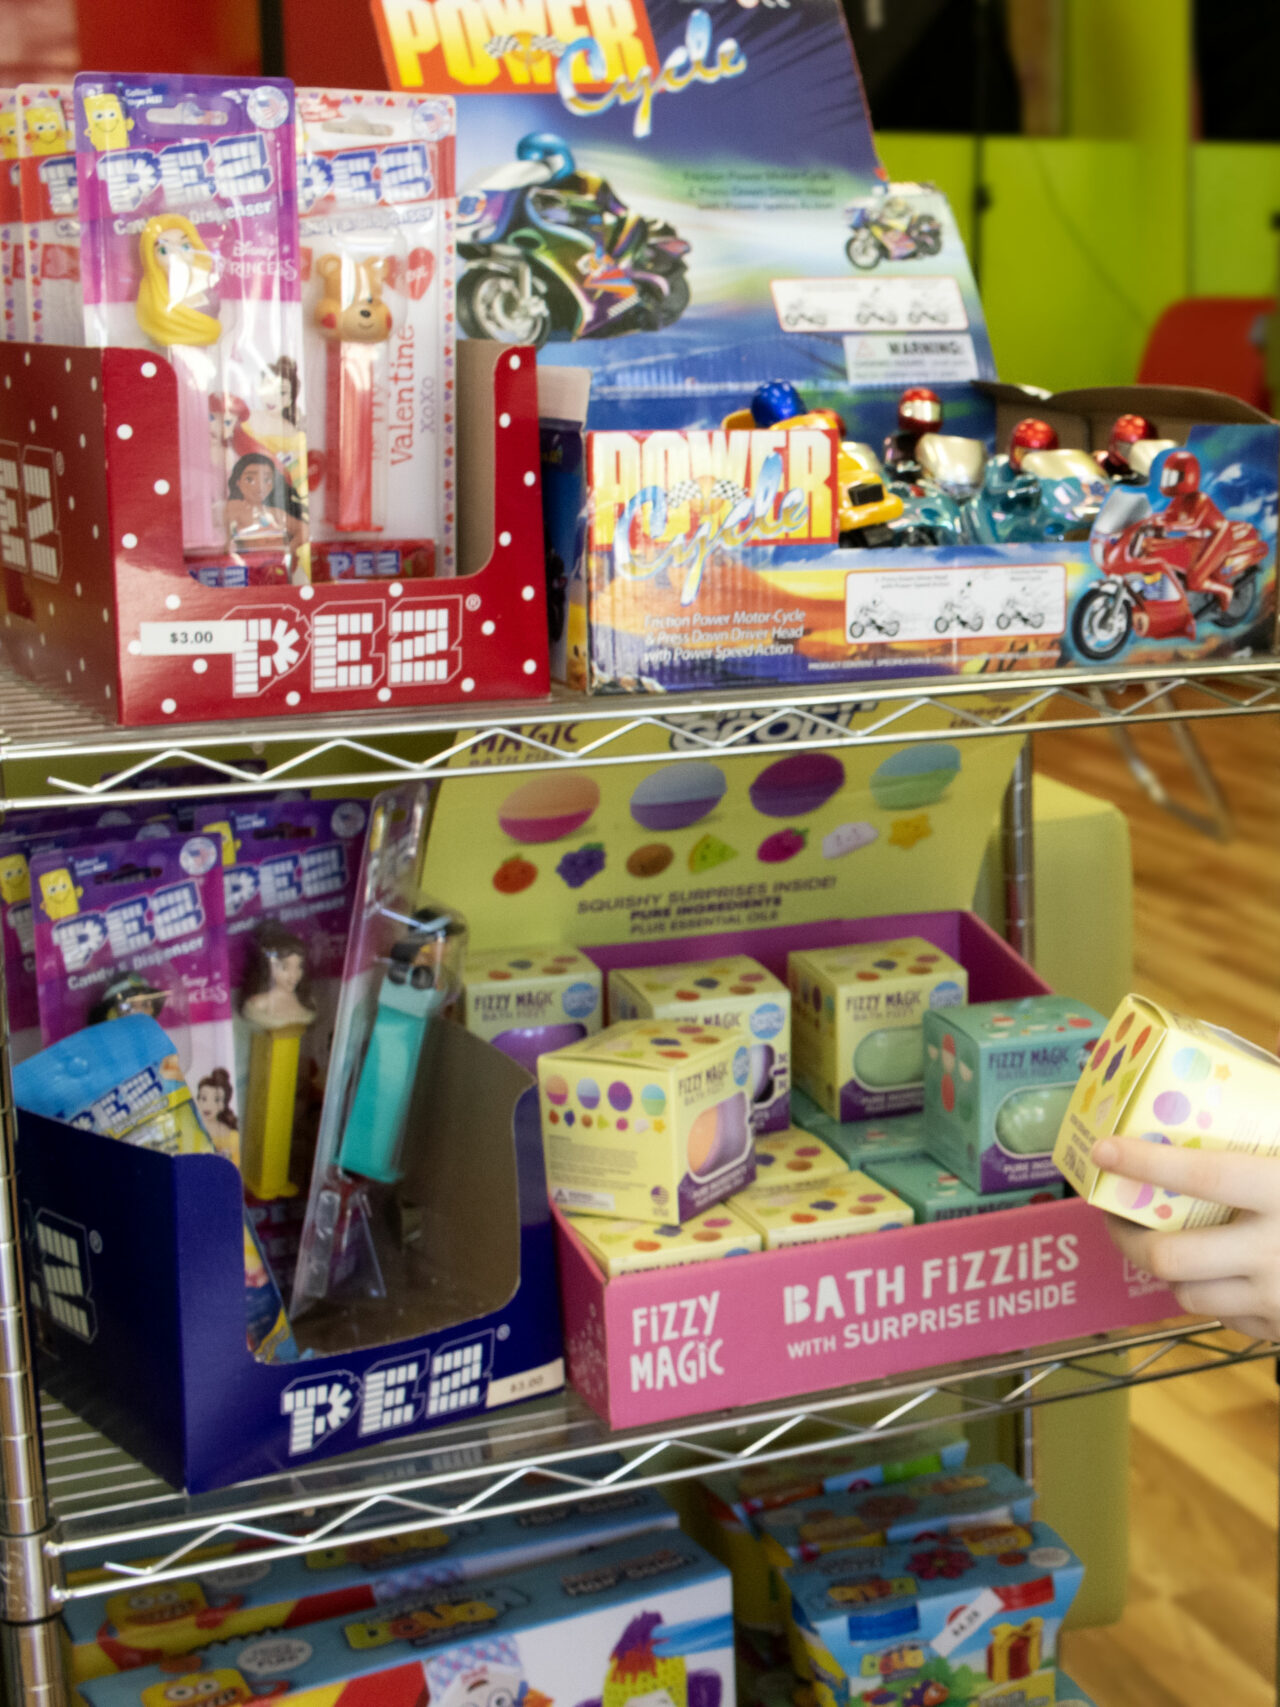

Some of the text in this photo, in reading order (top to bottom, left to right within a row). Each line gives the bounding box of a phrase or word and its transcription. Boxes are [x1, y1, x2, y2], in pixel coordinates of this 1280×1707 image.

[386, 0, 648, 87] POWER
[558, 9, 747, 138] Cycle
[97, 132, 273, 213] PEZ
[389, 325, 415, 466] Valentine
[594, 431, 832, 545] POWER
[327, 550, 400, 578] PEZ
[615, 452, 809, 606] Cycle
[170, 631, 213, 645] $3.00
[229, 597, 462, 698] PEZ
[692, 628, 730, 643] Down
[693, 612, 730, 627] Power
[53, 877, 205, 973] PEZ
[669, 883, 768, 906] SURPRISES
[670, 914, 741, 931] ESSENTIAL
[676, 896, 782, 916] INGREDIENTS
[67, 966, 114, 990] Candy
[133, 936, 204, 970] Dispenser
[782, 1266, 906, 1325] BATH
[787, 1281, 1078, 1359] WITH SURPRISE INSIDE
[281, 1329, 495, 1456] PEZ
